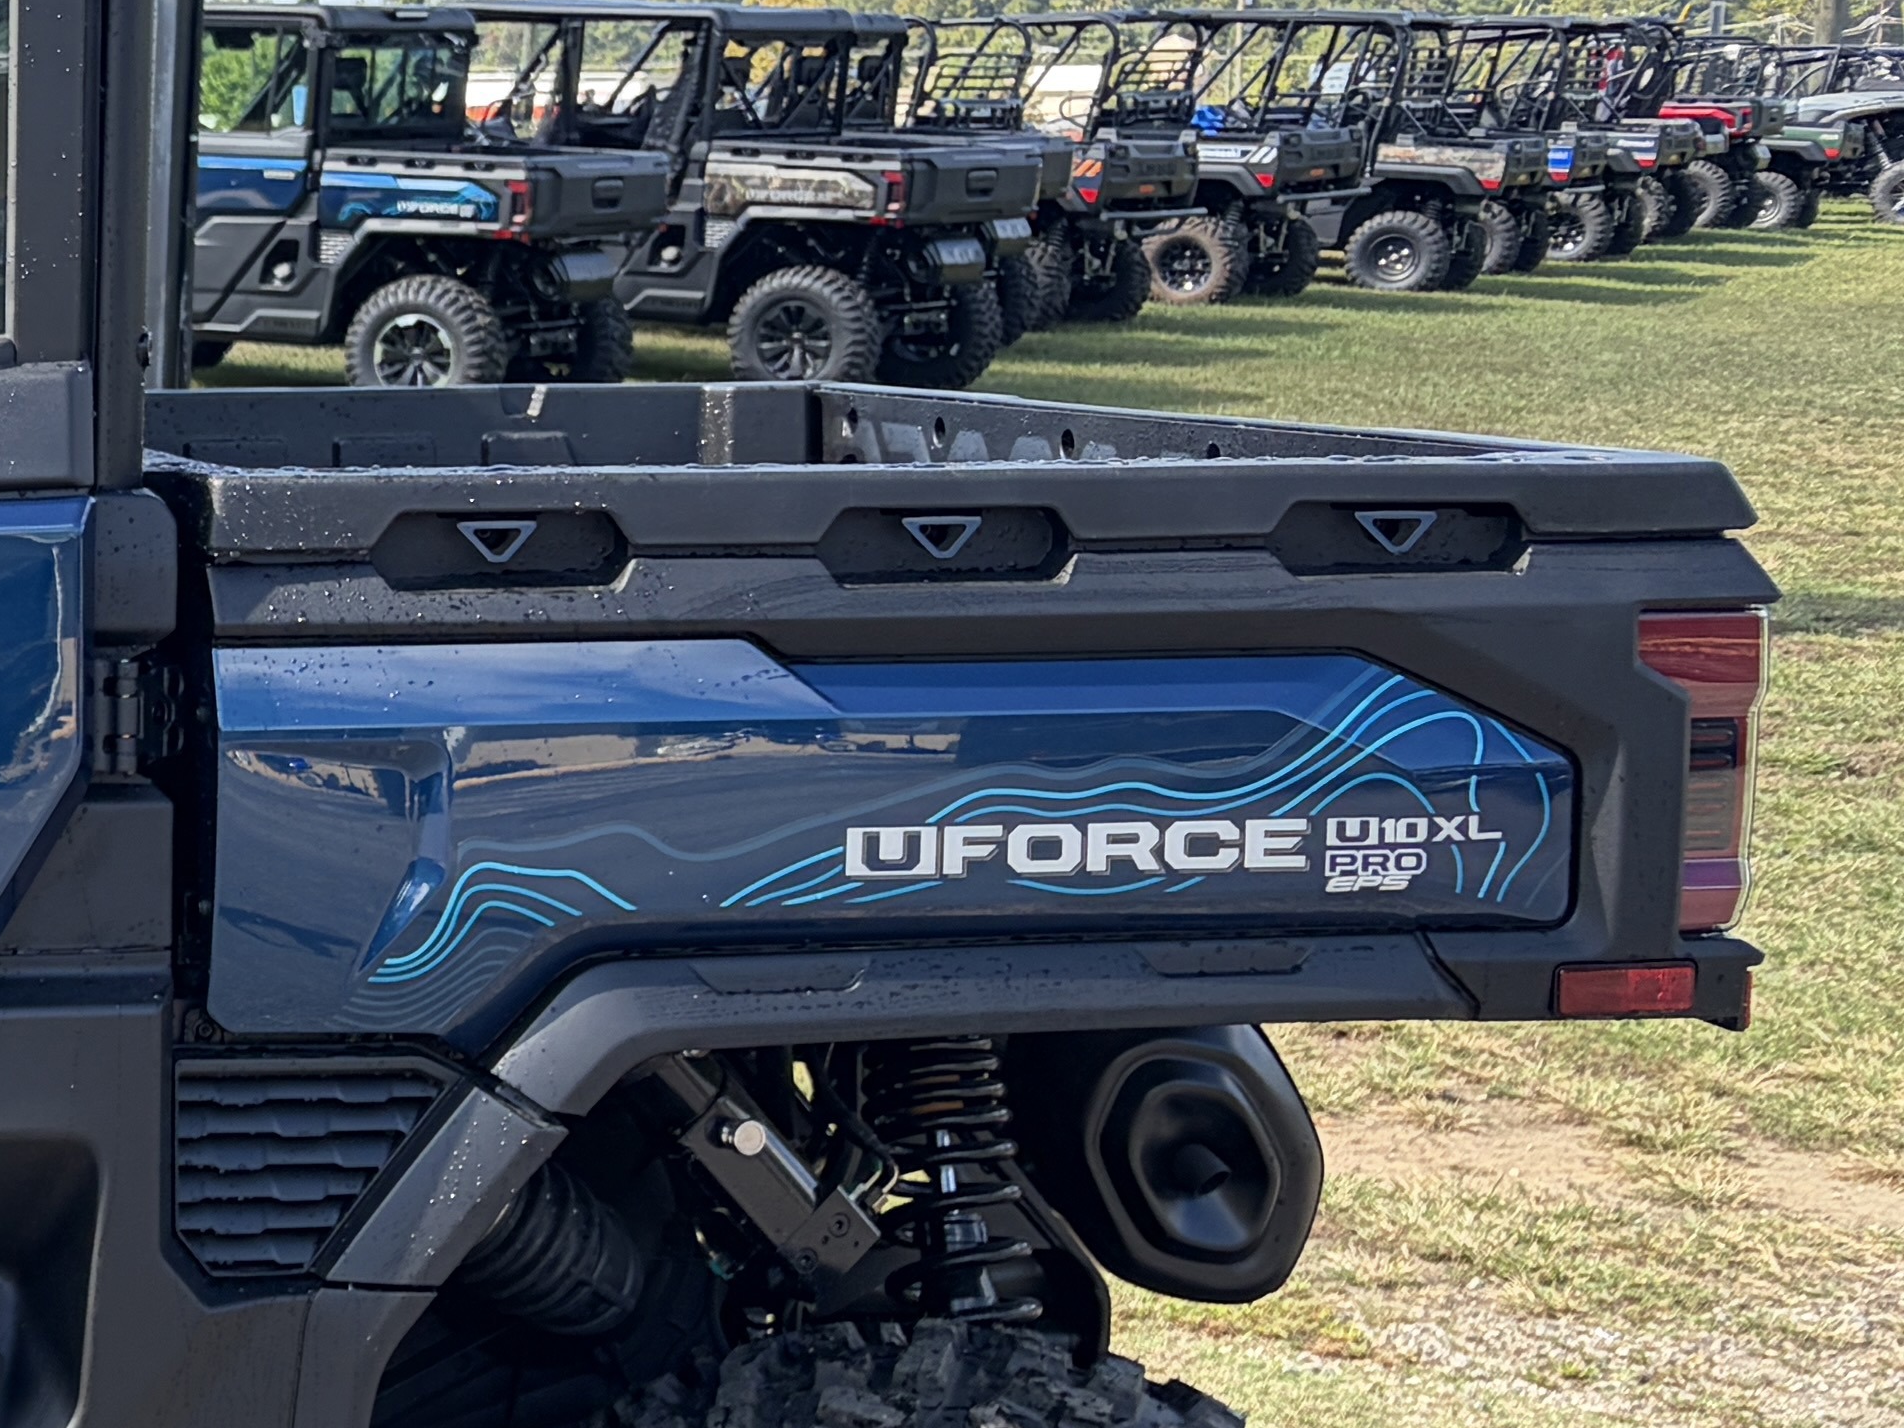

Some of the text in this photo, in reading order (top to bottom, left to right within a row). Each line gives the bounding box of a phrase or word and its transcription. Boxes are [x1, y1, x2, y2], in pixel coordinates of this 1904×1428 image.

[845, 818, 1310, 879] UFORCE
[1325, 848, 1427, 877] PRO
[1325, 875, 1412, 892] EPS
